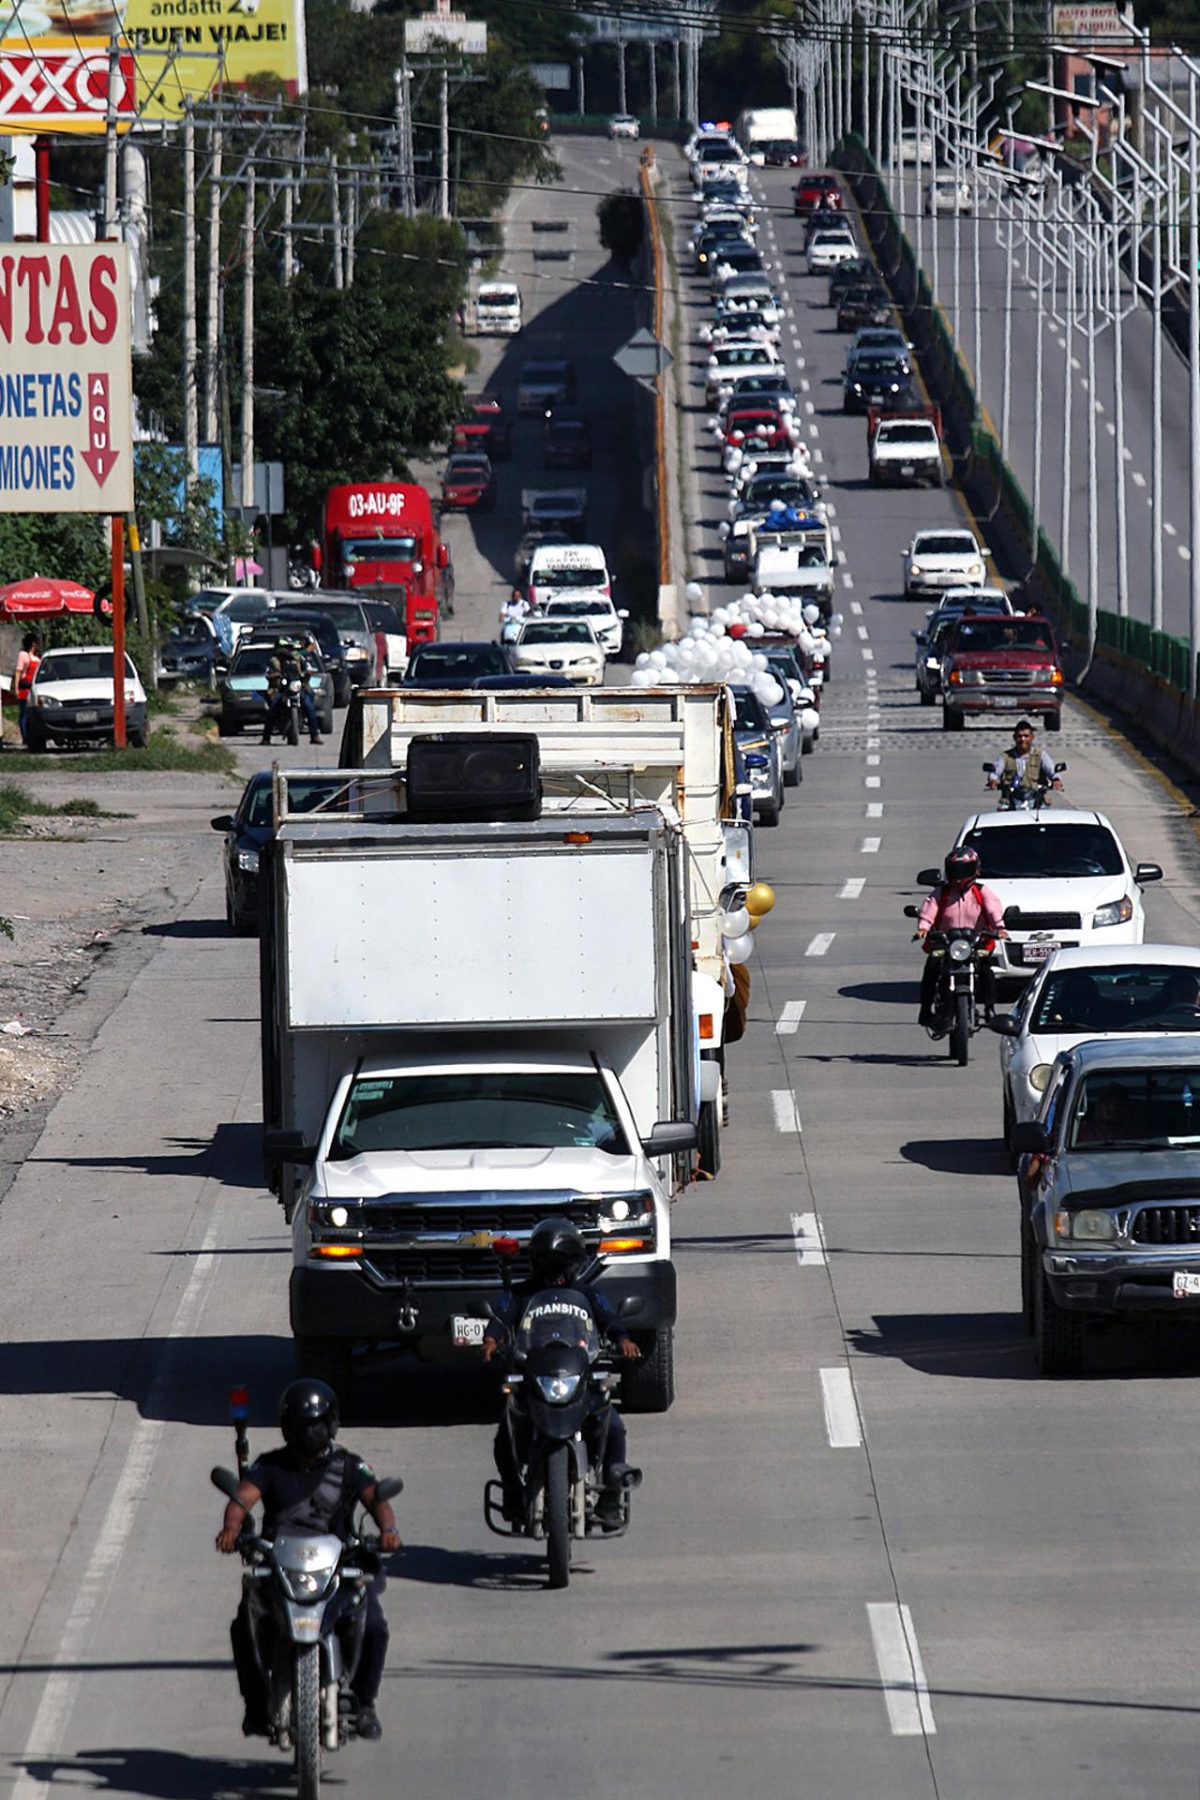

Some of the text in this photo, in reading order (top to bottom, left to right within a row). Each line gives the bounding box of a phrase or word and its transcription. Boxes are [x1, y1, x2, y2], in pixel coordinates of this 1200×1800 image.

[151, 0, 221, 15] andatti
[208, 23, 287, 43] VIAJE!
[0, 58, 126, 110] XXO
[93, 379, 106, 474] AQUI
[0, 444, 75, 490] MIONES
[529, 1303, 588, 1320] TRANSITO
